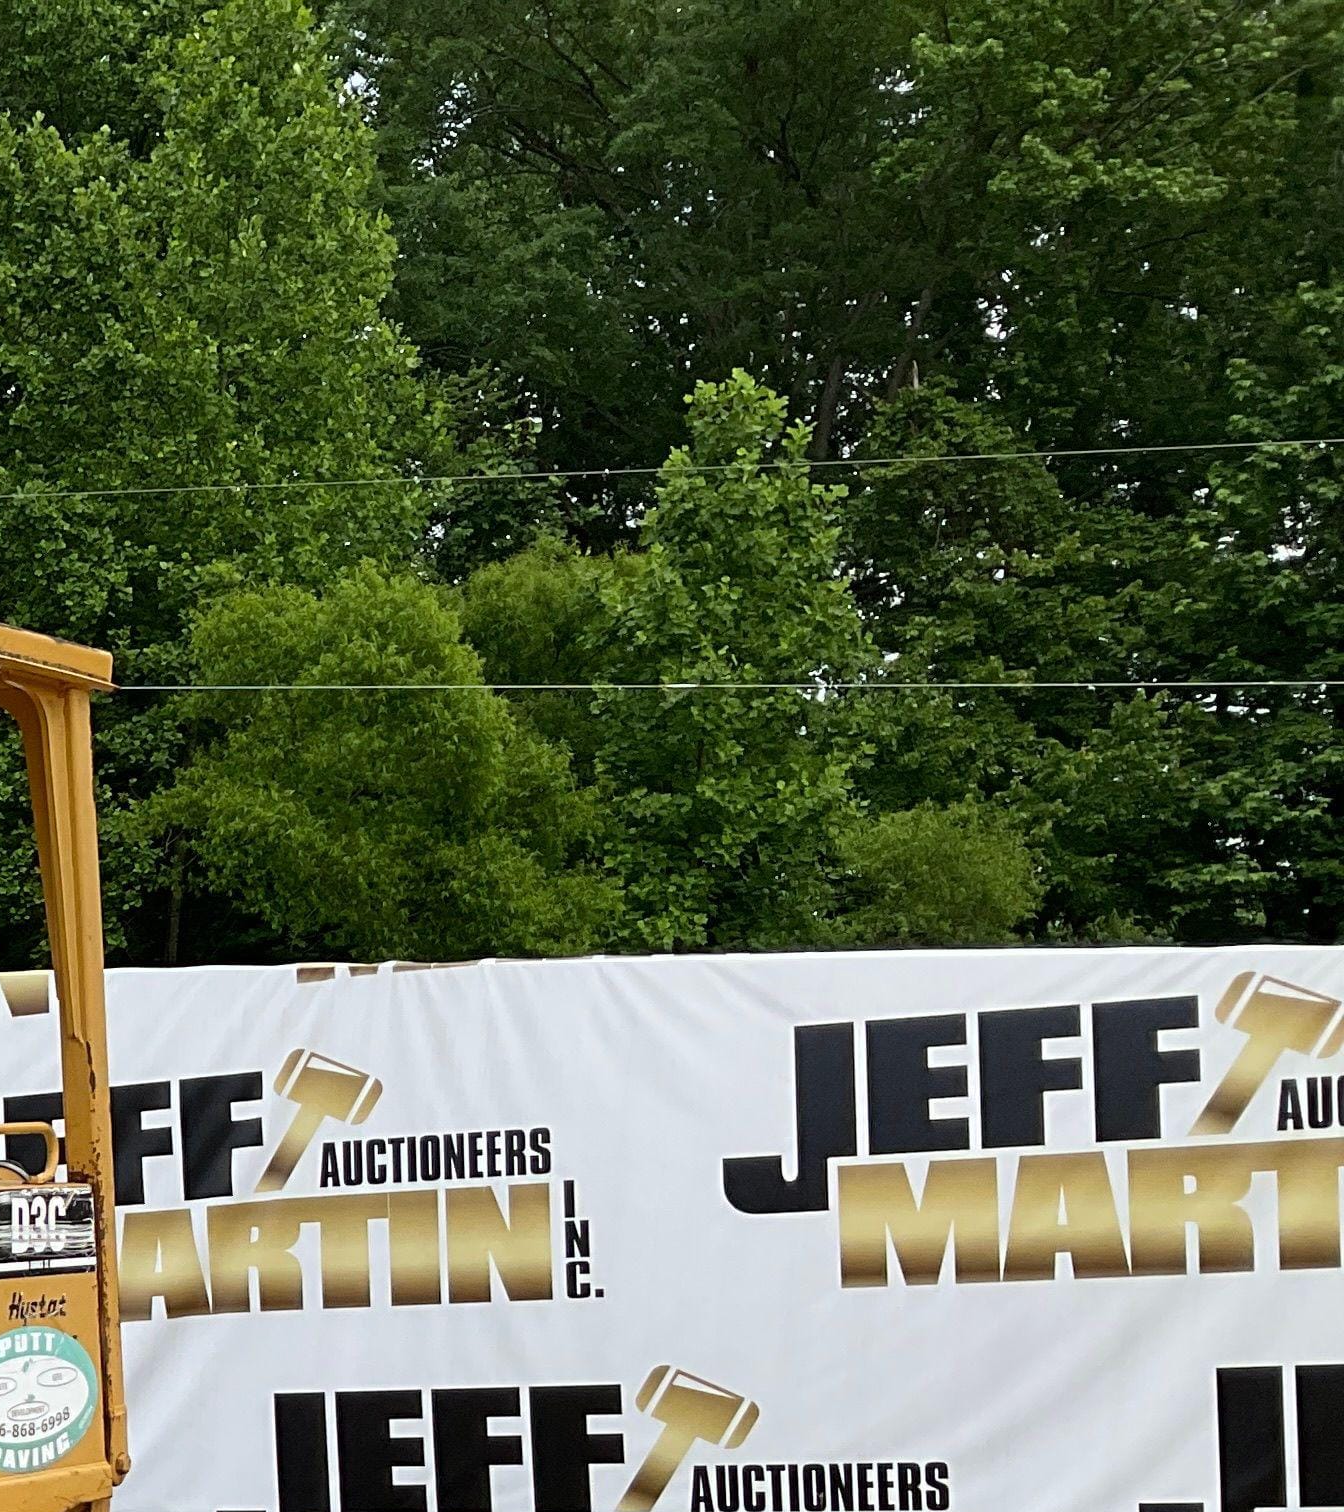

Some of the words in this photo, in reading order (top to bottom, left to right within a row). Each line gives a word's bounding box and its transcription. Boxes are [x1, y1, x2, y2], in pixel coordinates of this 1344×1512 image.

[722, 995, 1201, 1214] JEFF
[320, 1128, 551, 1187] AUCTIONEERS
[12, 1196, 66, 1253] D3C
[118, 1182, 553, 1322] ARTIN
[563, 1180, 605, 1299] INC.
[837, 1137, 1344, 1288] MART
[0, 1332, 56, 1358] PUTT
[690, 1461, 950, 1512] AUCTIONEERS
